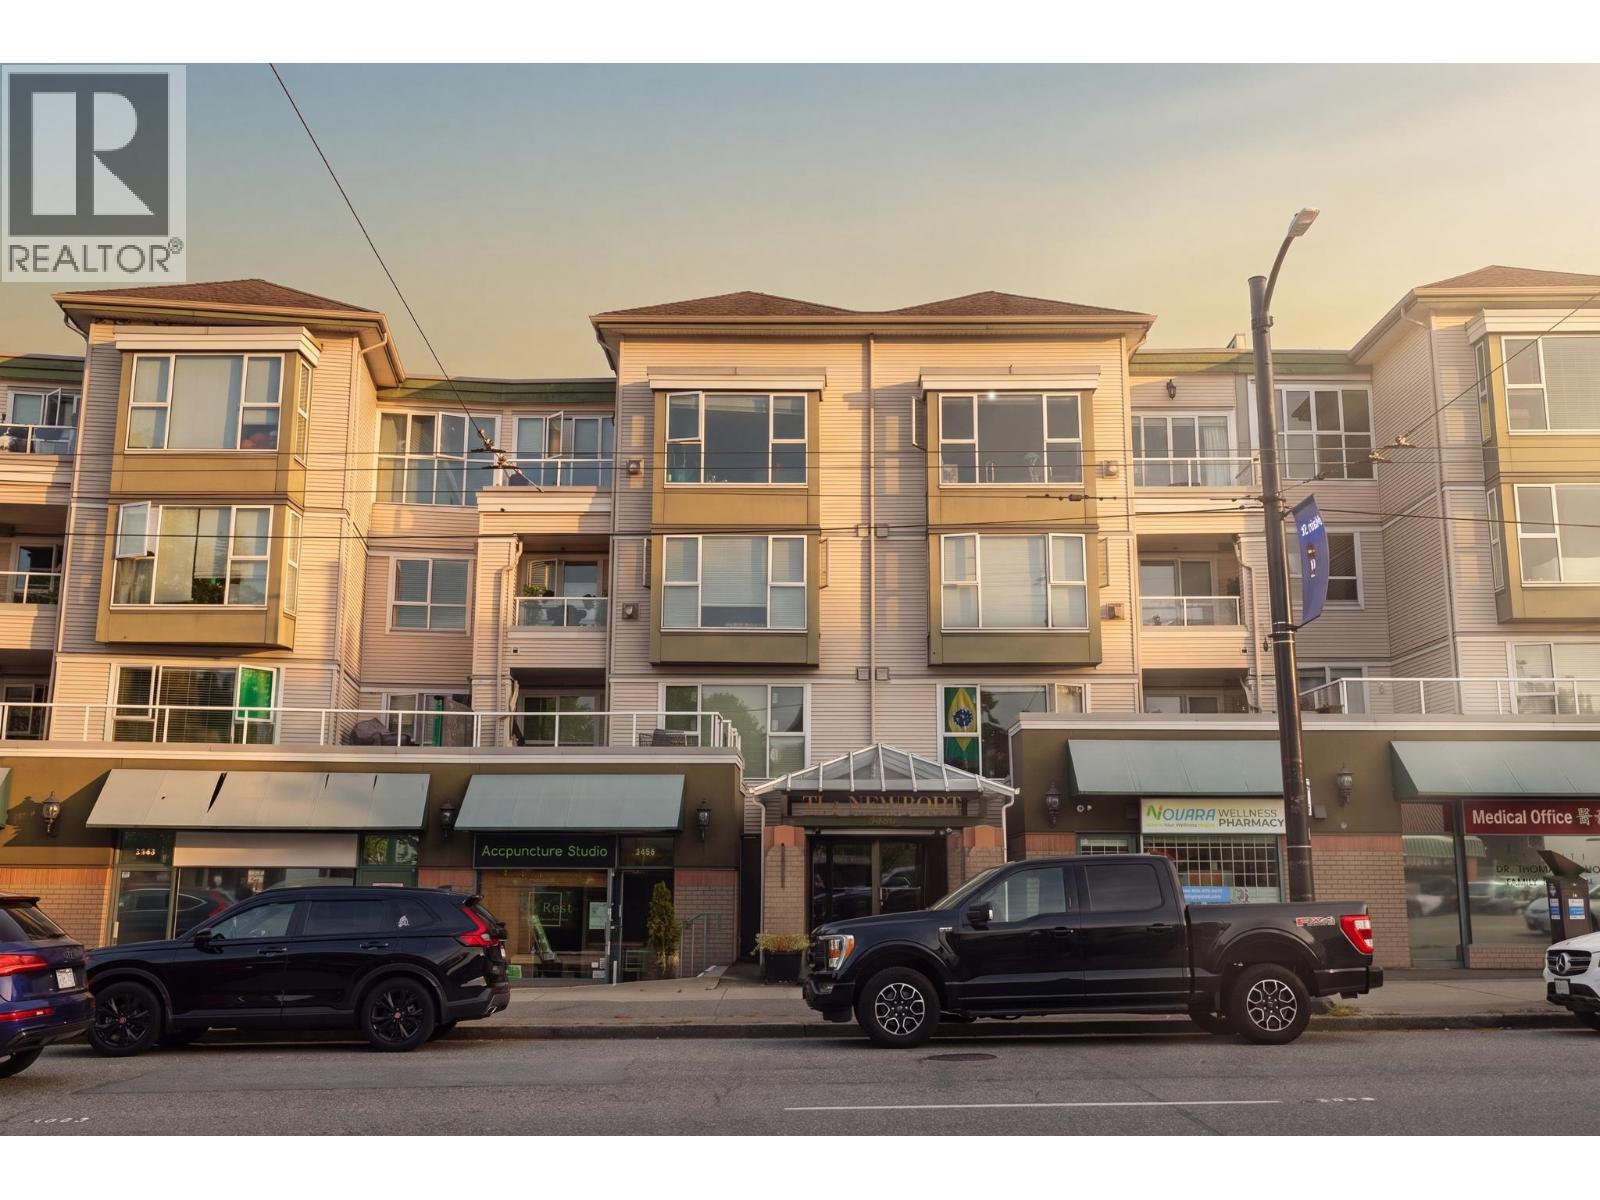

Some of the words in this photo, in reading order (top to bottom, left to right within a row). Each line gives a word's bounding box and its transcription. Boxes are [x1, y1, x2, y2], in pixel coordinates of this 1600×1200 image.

[1218, 808, 1278, 818] WELLNESS
[1472, 809, 1527, 824] Medical
[1530, 809, 1573, 824] Office
[1218, 818, 1285, 828] PHARMACY
[567, 845, 608, 857] Studio
[1296, 916, 1336, 927] FX4
